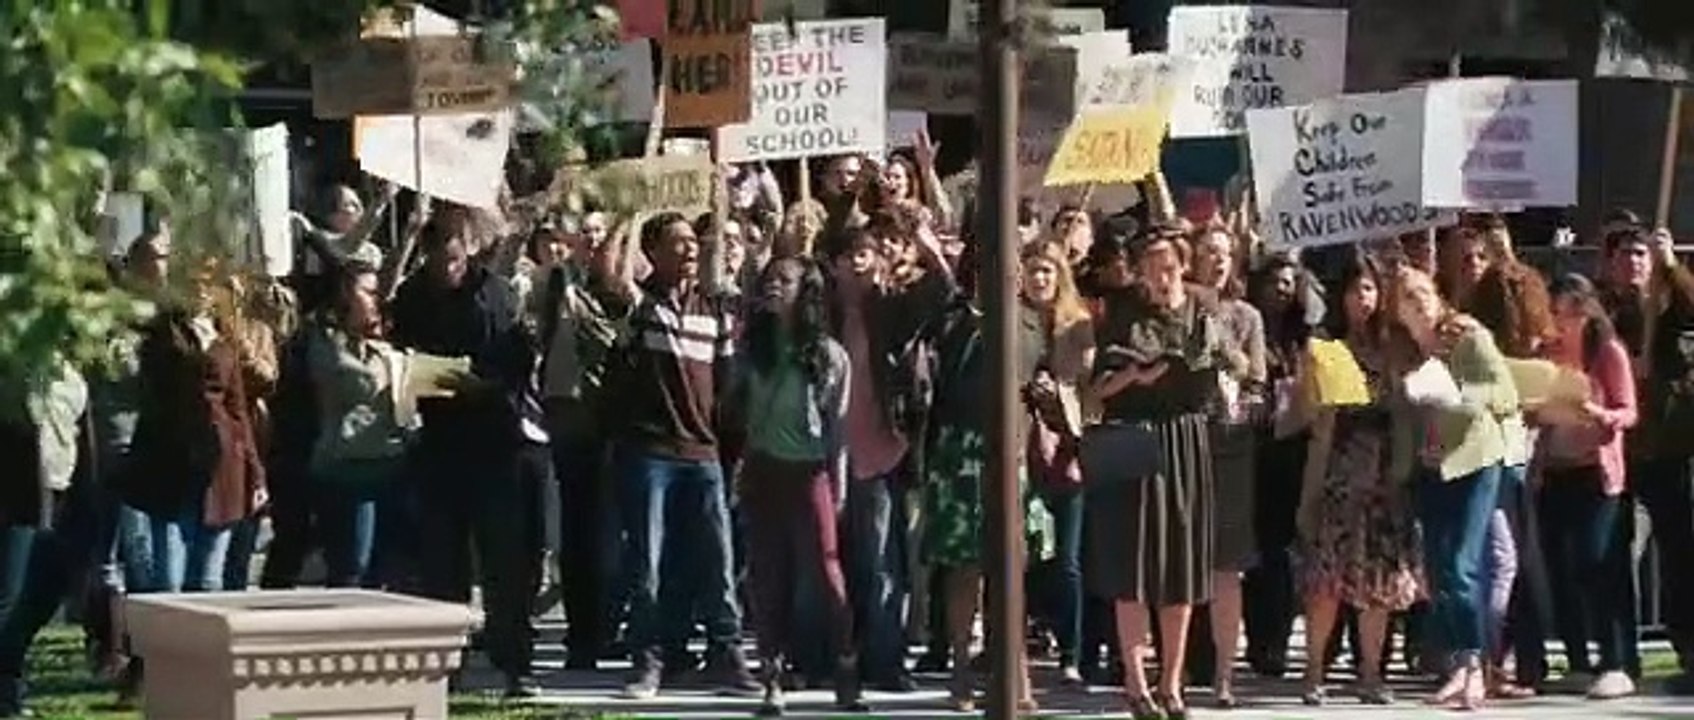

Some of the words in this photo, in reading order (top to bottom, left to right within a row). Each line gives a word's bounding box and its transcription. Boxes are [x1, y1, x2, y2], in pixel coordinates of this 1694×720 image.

[753, 30, 799, 53] EEP
[810, 26, 865, 48] THE
[757, 52, 844, 77] DEVIL
[755, 81, 804, 101] OUT
[814, 77, 849, 98] OF
[774, 104, 828, 126] OUR
[1293, 109, 1340, 145] Keep
[746, 127, 858, 155] SCHOOL!
[1293, 147, 1379, 177] Children
